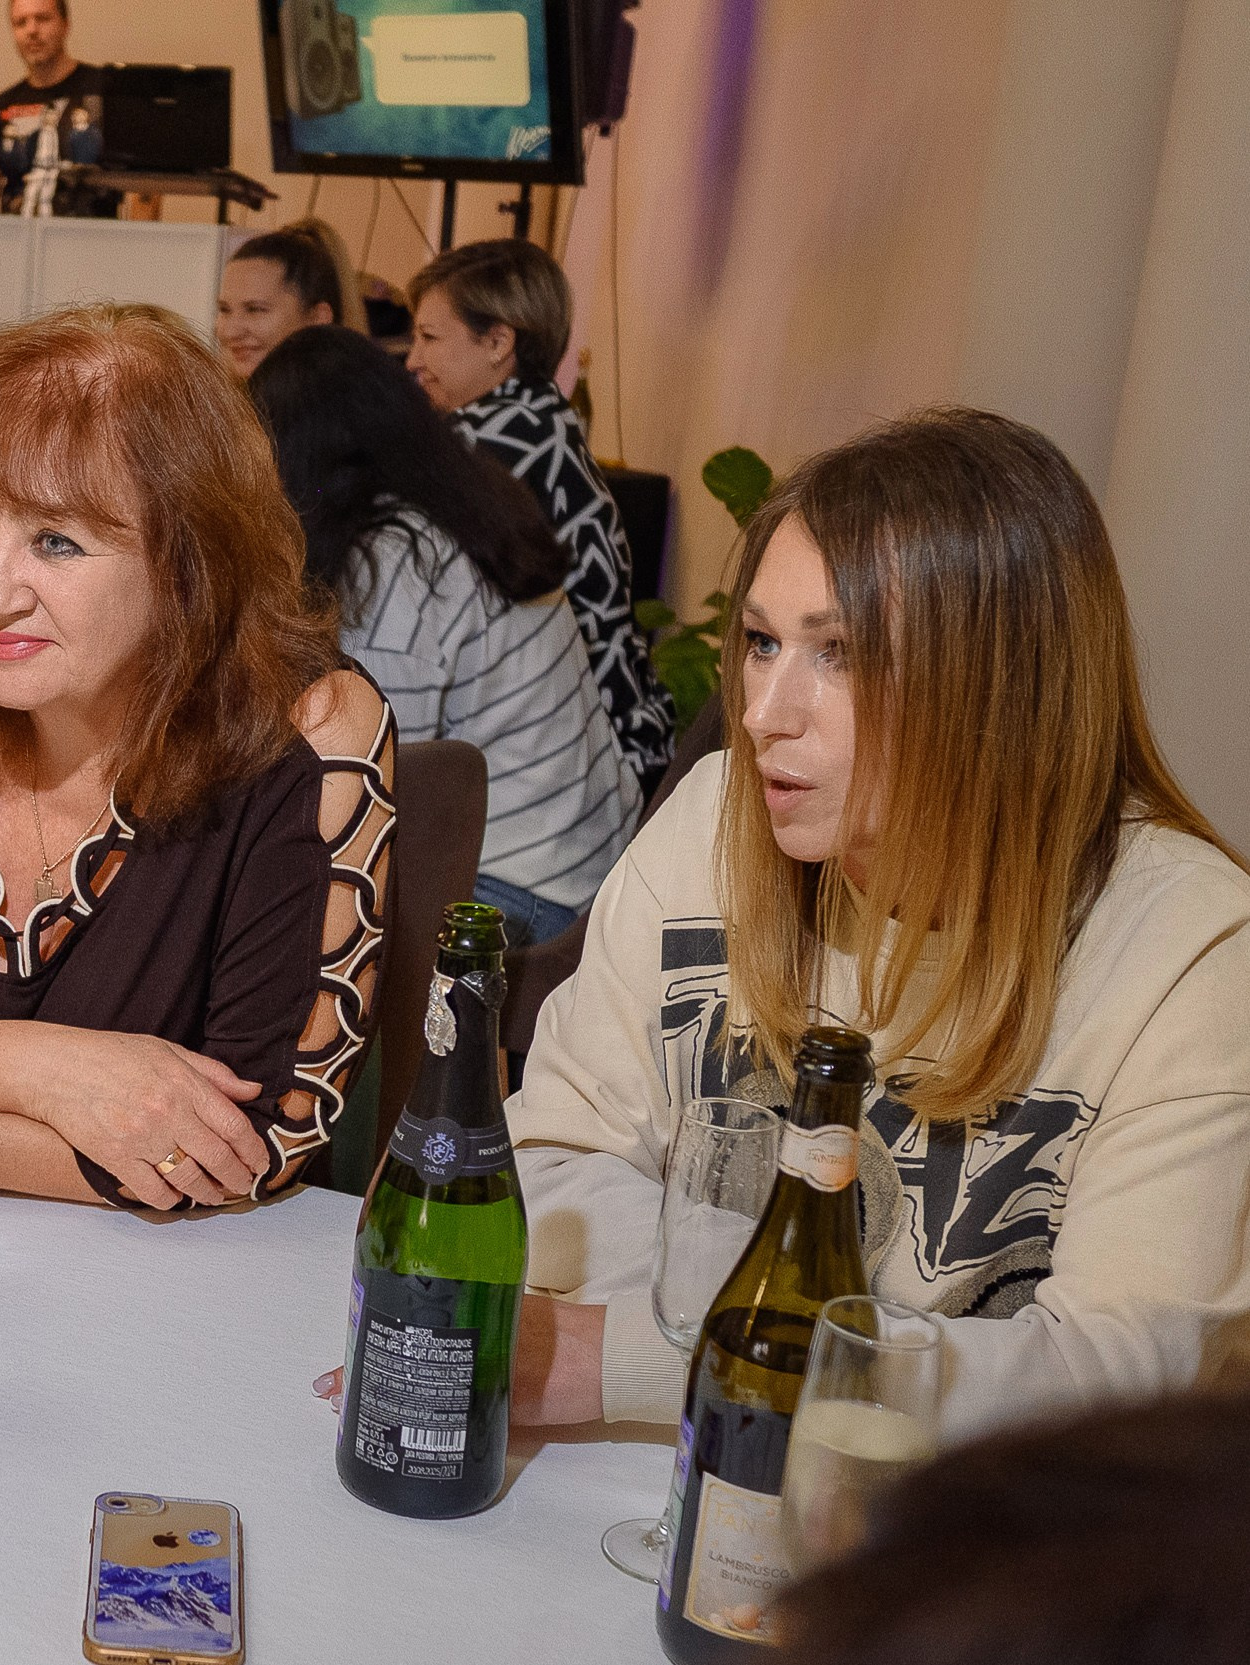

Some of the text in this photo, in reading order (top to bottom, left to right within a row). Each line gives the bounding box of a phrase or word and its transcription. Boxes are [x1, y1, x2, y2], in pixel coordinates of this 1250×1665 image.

[423, 1164, 446, 1176] DOUX
[708, 1549, 791, 1580] LAMBRUSCO
[720, 1568, 772, 1591] BIANCO
